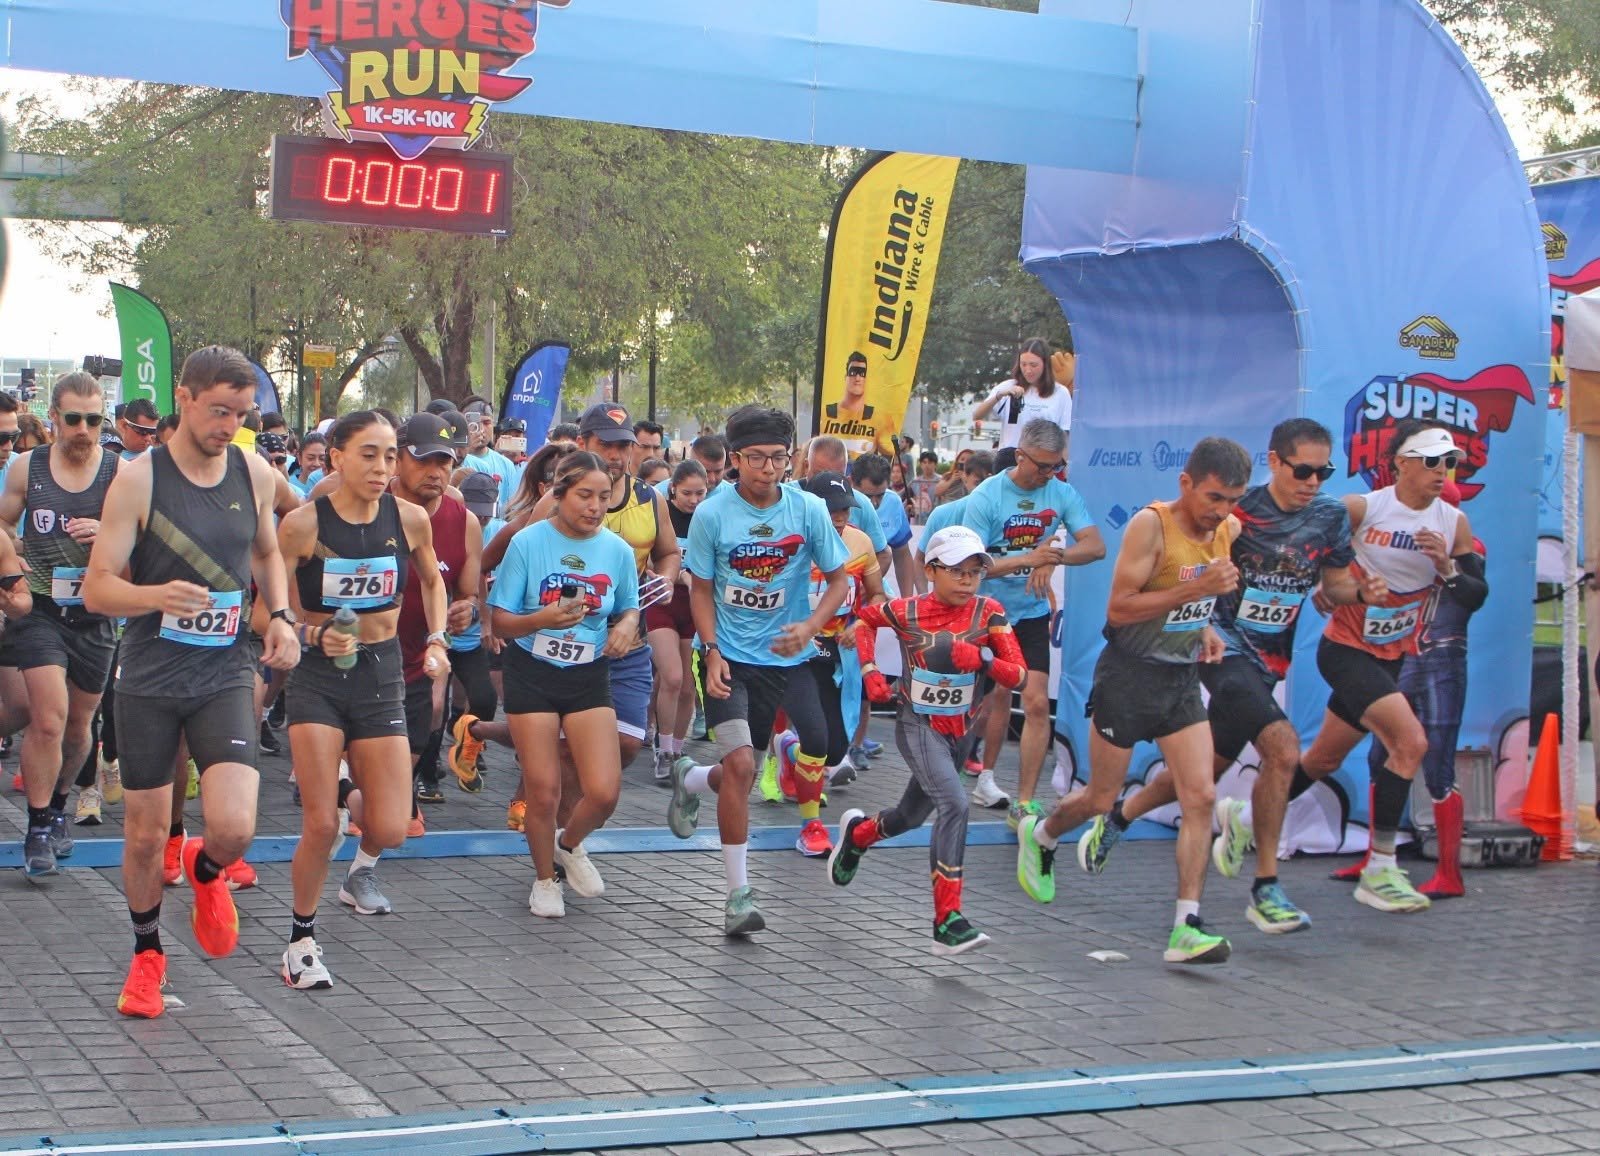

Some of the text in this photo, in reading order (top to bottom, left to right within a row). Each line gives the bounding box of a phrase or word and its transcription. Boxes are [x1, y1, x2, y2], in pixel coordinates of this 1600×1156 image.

[350, 48, 480, 104] RUN
[362, 105, 456, 129] 1K-5K-10K
[324, 157, 497, 213] 0:00:01
[904, 196, 935, 292] Wire & Cable
[868, 191, 919, 350] Indiana
[1364, 373, 1480, 433] SÚPER
[1350, 416, 1489, 473] HÉES
[1101, 450, 1142, 467] CEMEX
[339, 576, 382, 596] 276
[731, 589, 780, 609] 1017
[1171, 601, 1212, 622] 2643
[1246, 604, 1295, 623] 2167
[1369, 616, 1415, 635] 2644
[546, 640, 584, 662] 357
[921, 686, 963, 705] 498
